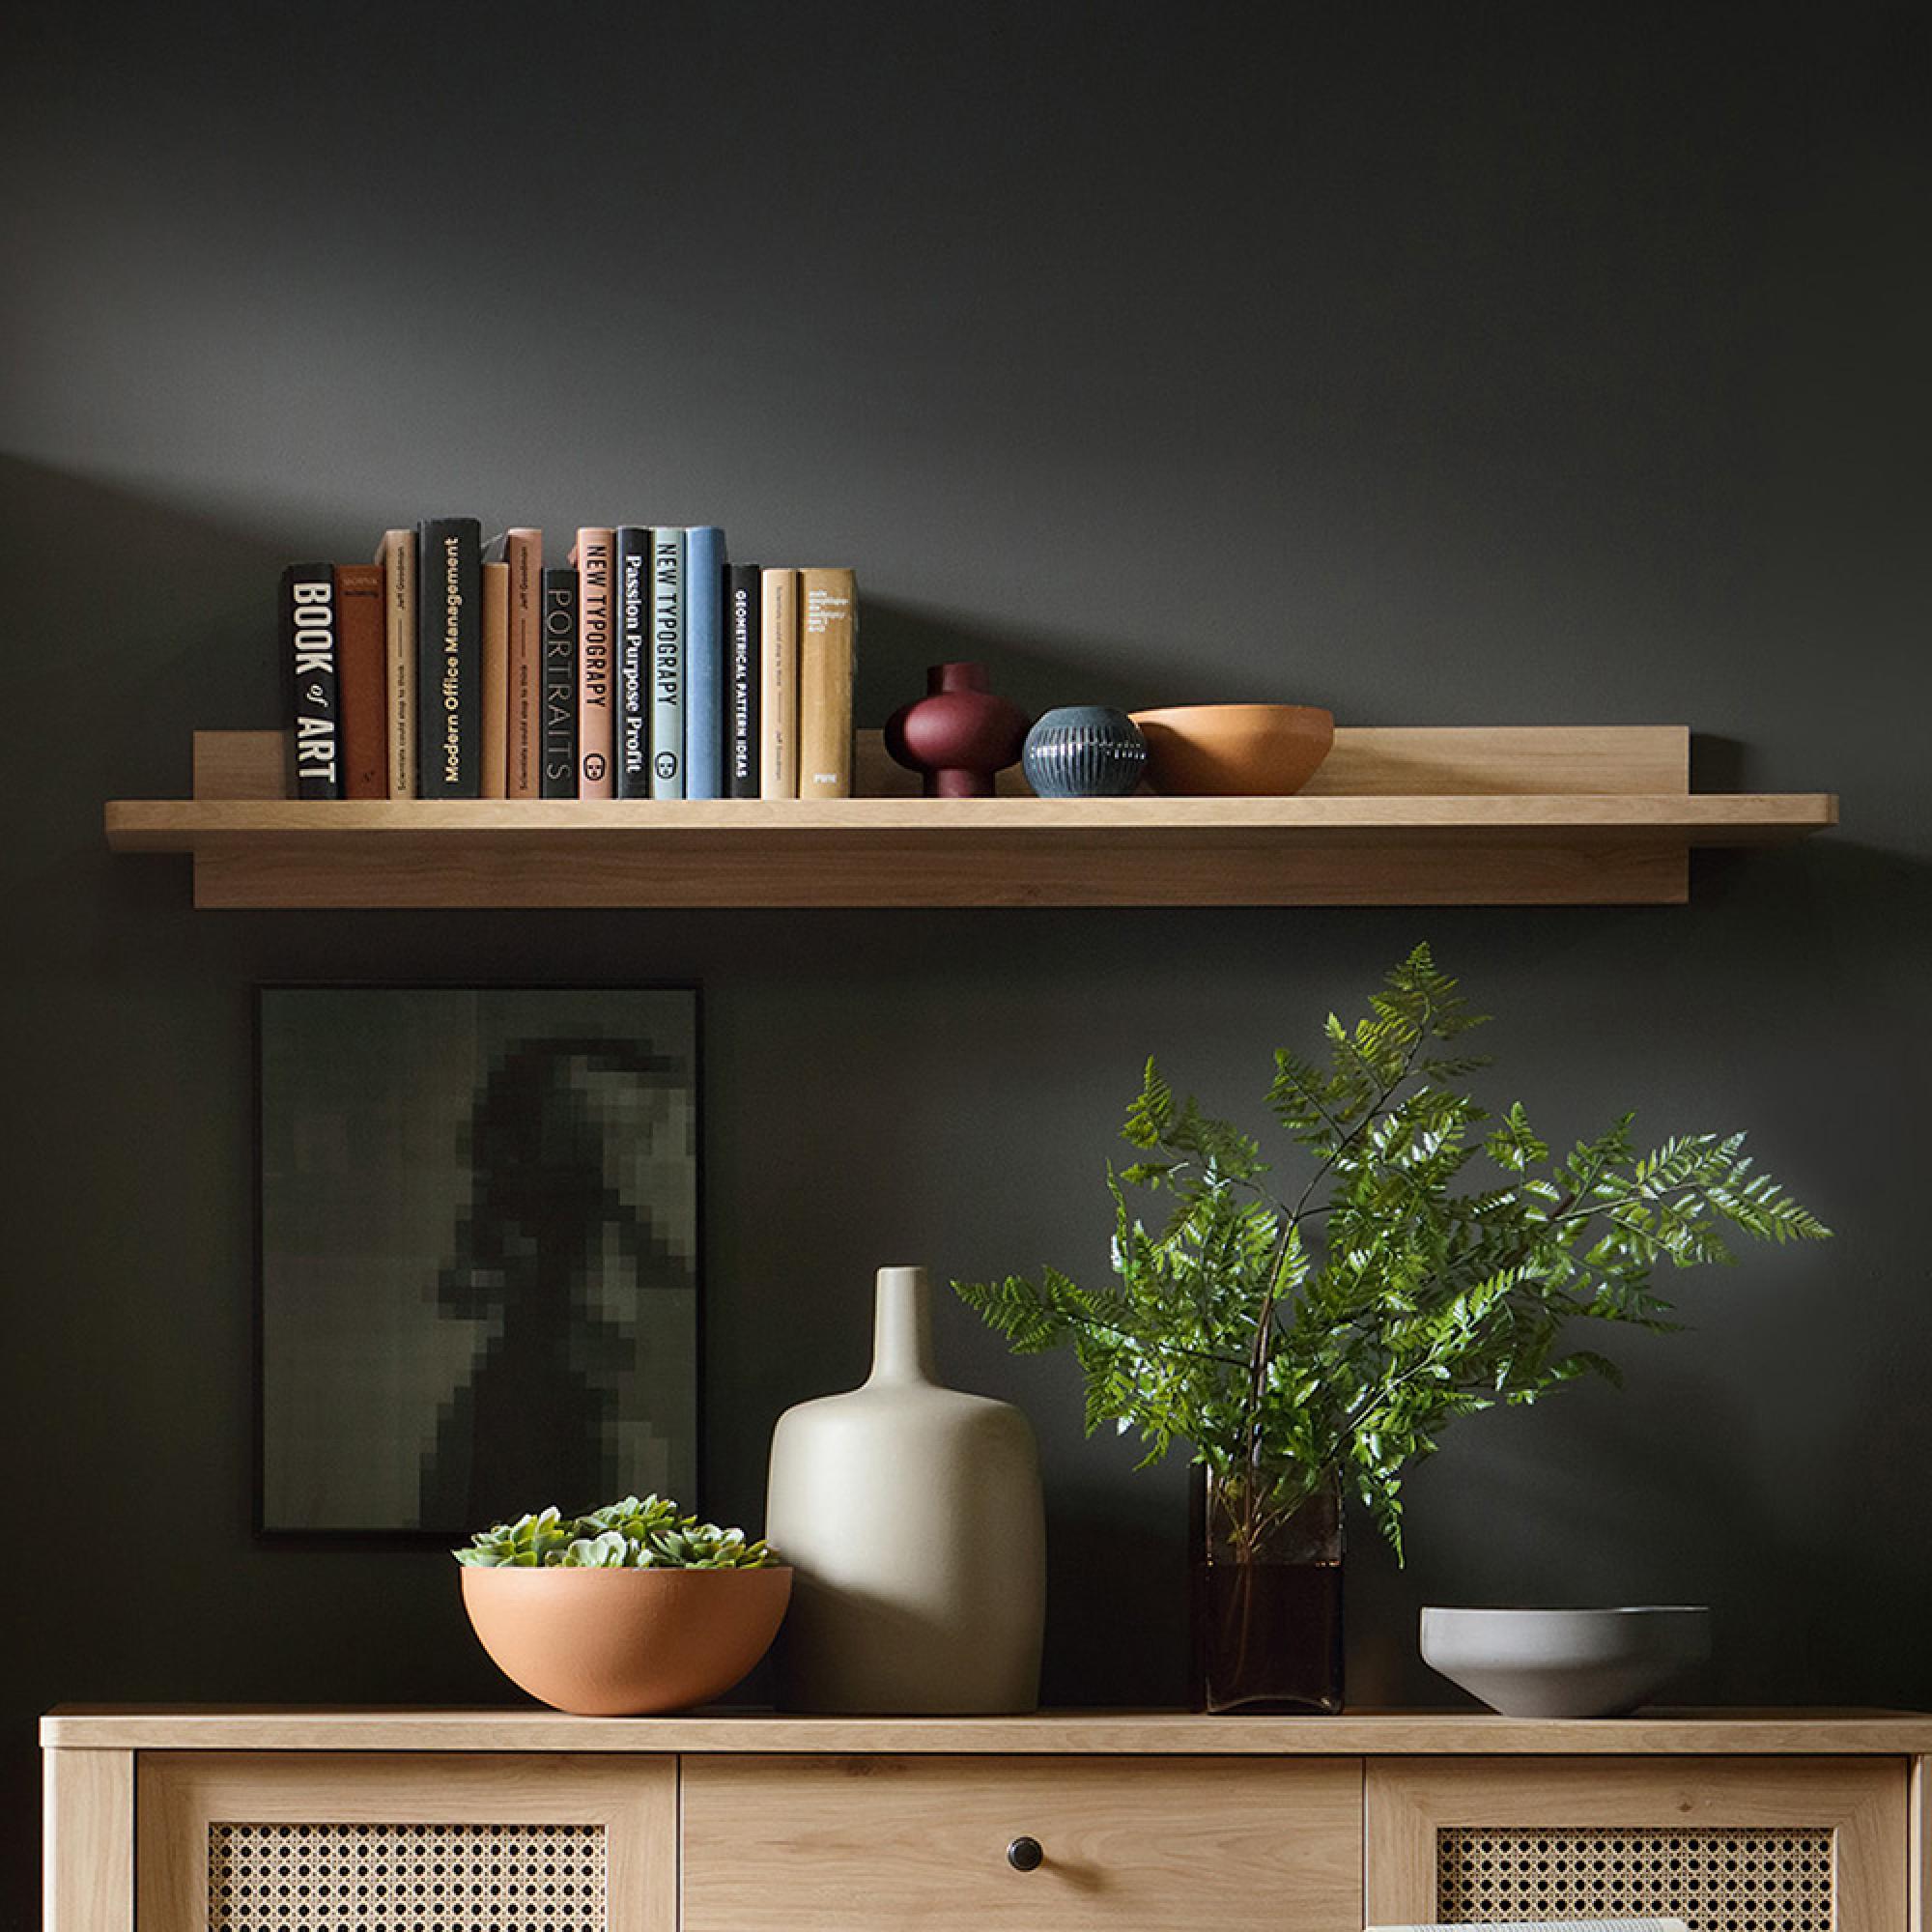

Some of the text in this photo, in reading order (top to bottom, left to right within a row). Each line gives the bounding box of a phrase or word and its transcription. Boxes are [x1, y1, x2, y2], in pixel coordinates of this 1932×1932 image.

[293, 582, 333, 674] BOOK
[441, 536, 462, 781] Modern Office Management
[547, 588, 573, 781] PORTRAITS
[585, 544, 608, 708] NEW TYPOGRAPY
[622, 555, 642, 773] Passion Purpose Profit
[656, 543, 677, 706] NEW TYPOGRAPY
[735, 590, 748, 778] GEOMETRICAL PATTERN IDEAS
[298, 717, 335, 783] ART
